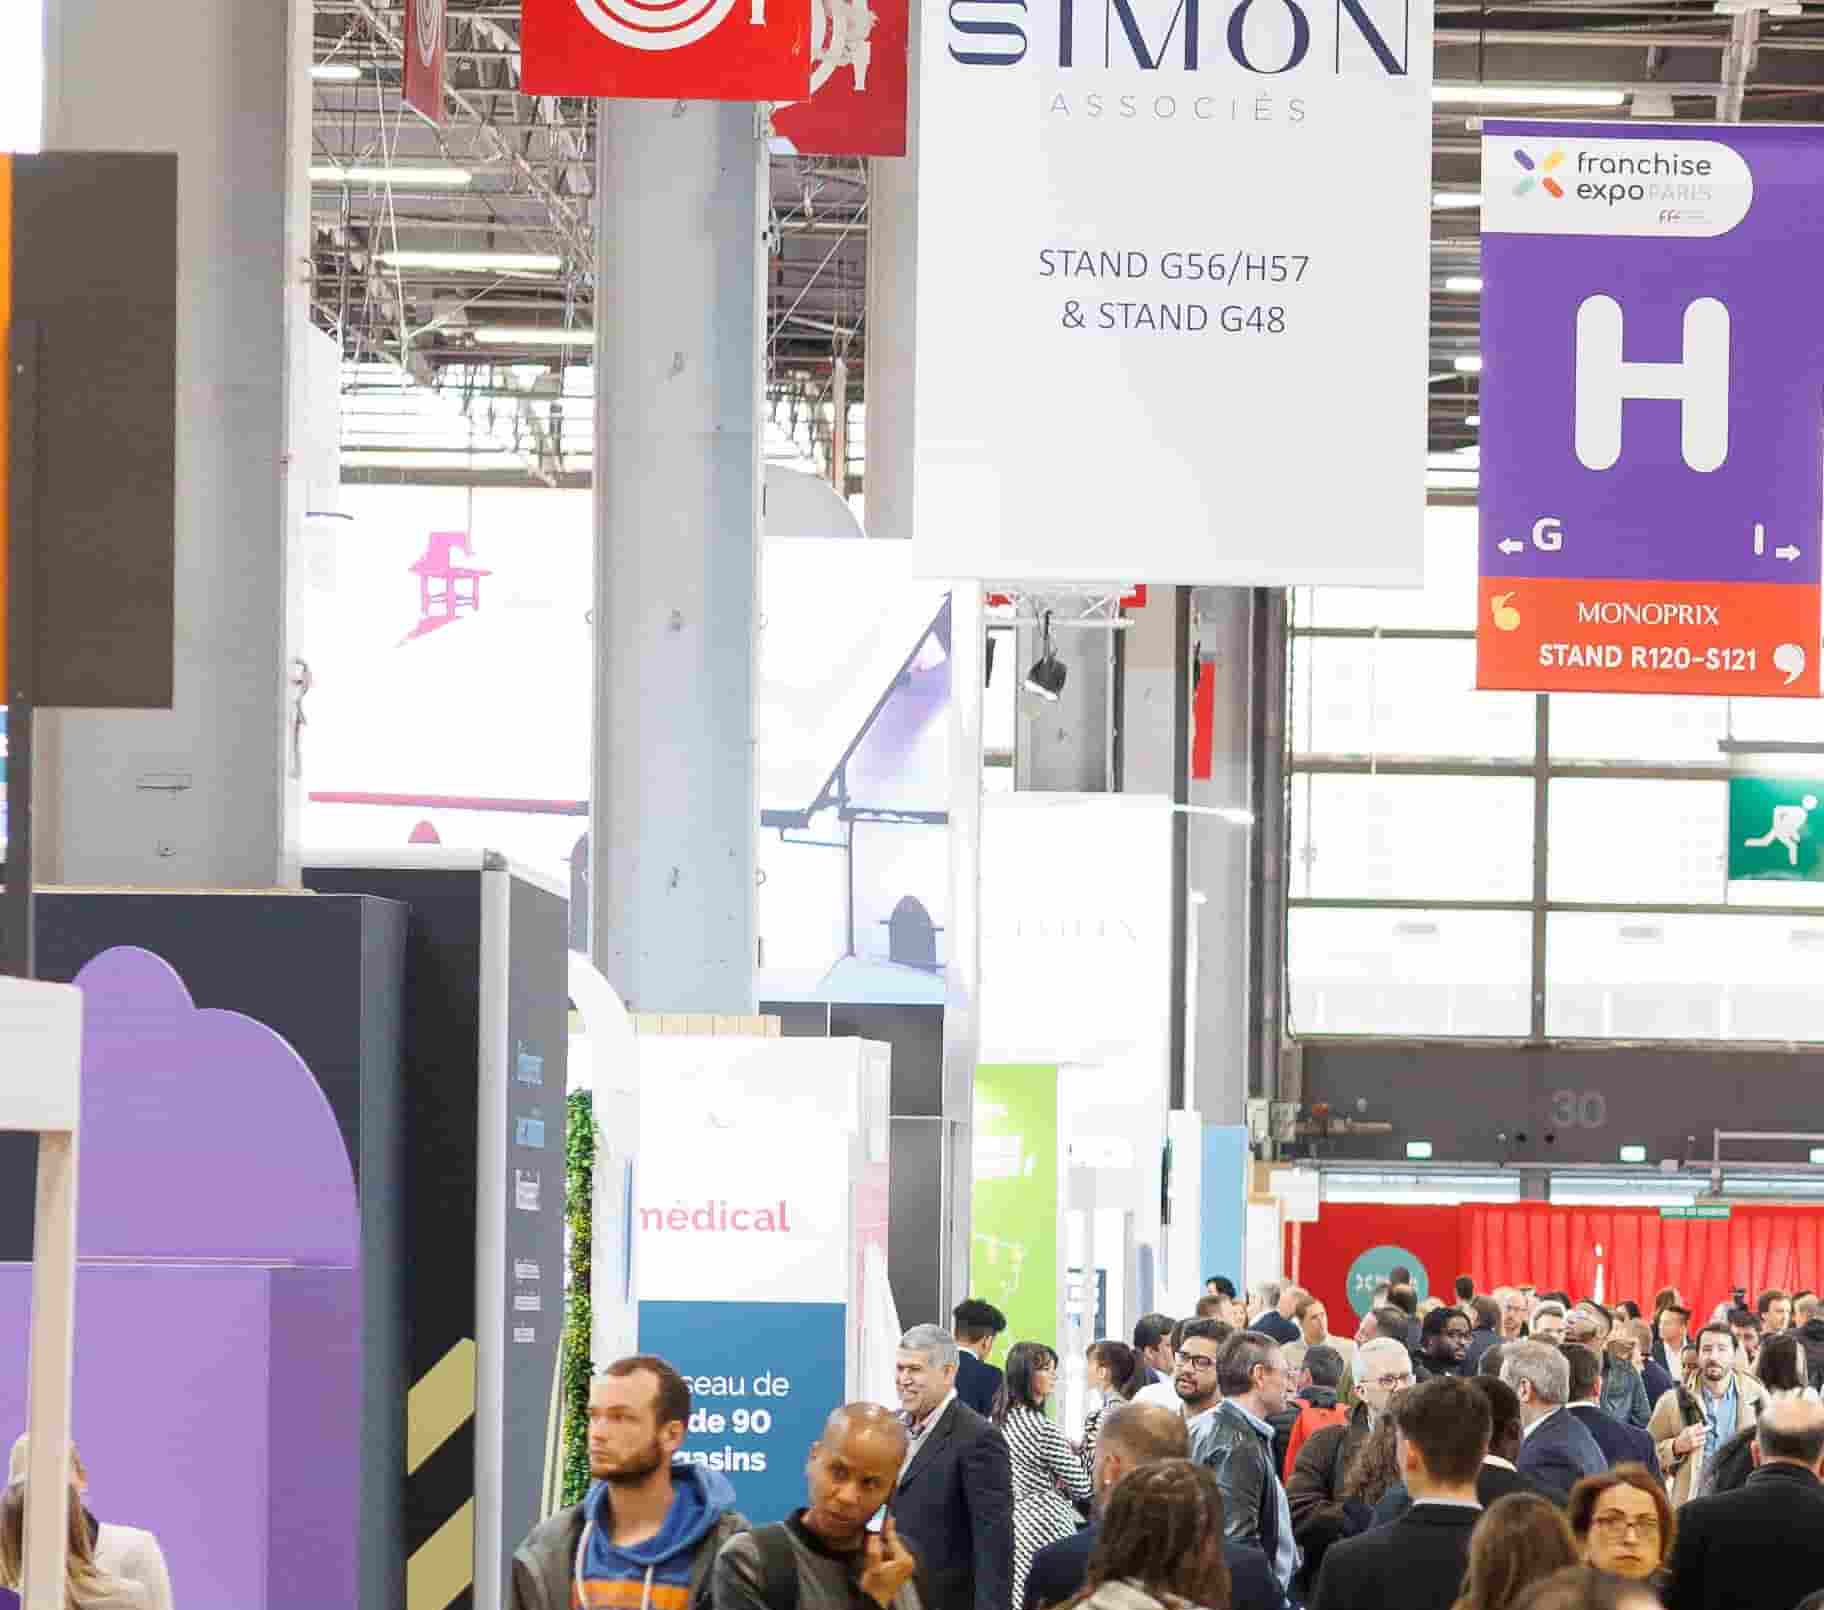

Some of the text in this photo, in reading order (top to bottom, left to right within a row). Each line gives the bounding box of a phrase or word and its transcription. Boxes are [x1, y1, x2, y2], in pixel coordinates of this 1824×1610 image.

[947, 0, 1409, 75] SIMON
[1050, 90, 1306, 121] ASSOCIÉS
[1577, 151, 1712, 176] franchise
[1576, 183, 1644, 207] expo
[1039, 249, 1310, 286] STAND G56/H57
[1062, 300, 1286, 334] & STAND G48
[1575, 294, 1731, 472] H
[1532, 517, 1564, 552] G
[1753, 523, 1766, 555] I
[1577, 601, 1720, 626] MONOPRIX
[1538, 643, 1757, 671] STAND R120-S121
[1552, 1088, 1606, 1129] 30
[753, 1368, 790, 1397] de
[688, 1408, 772, 1434] de 90
